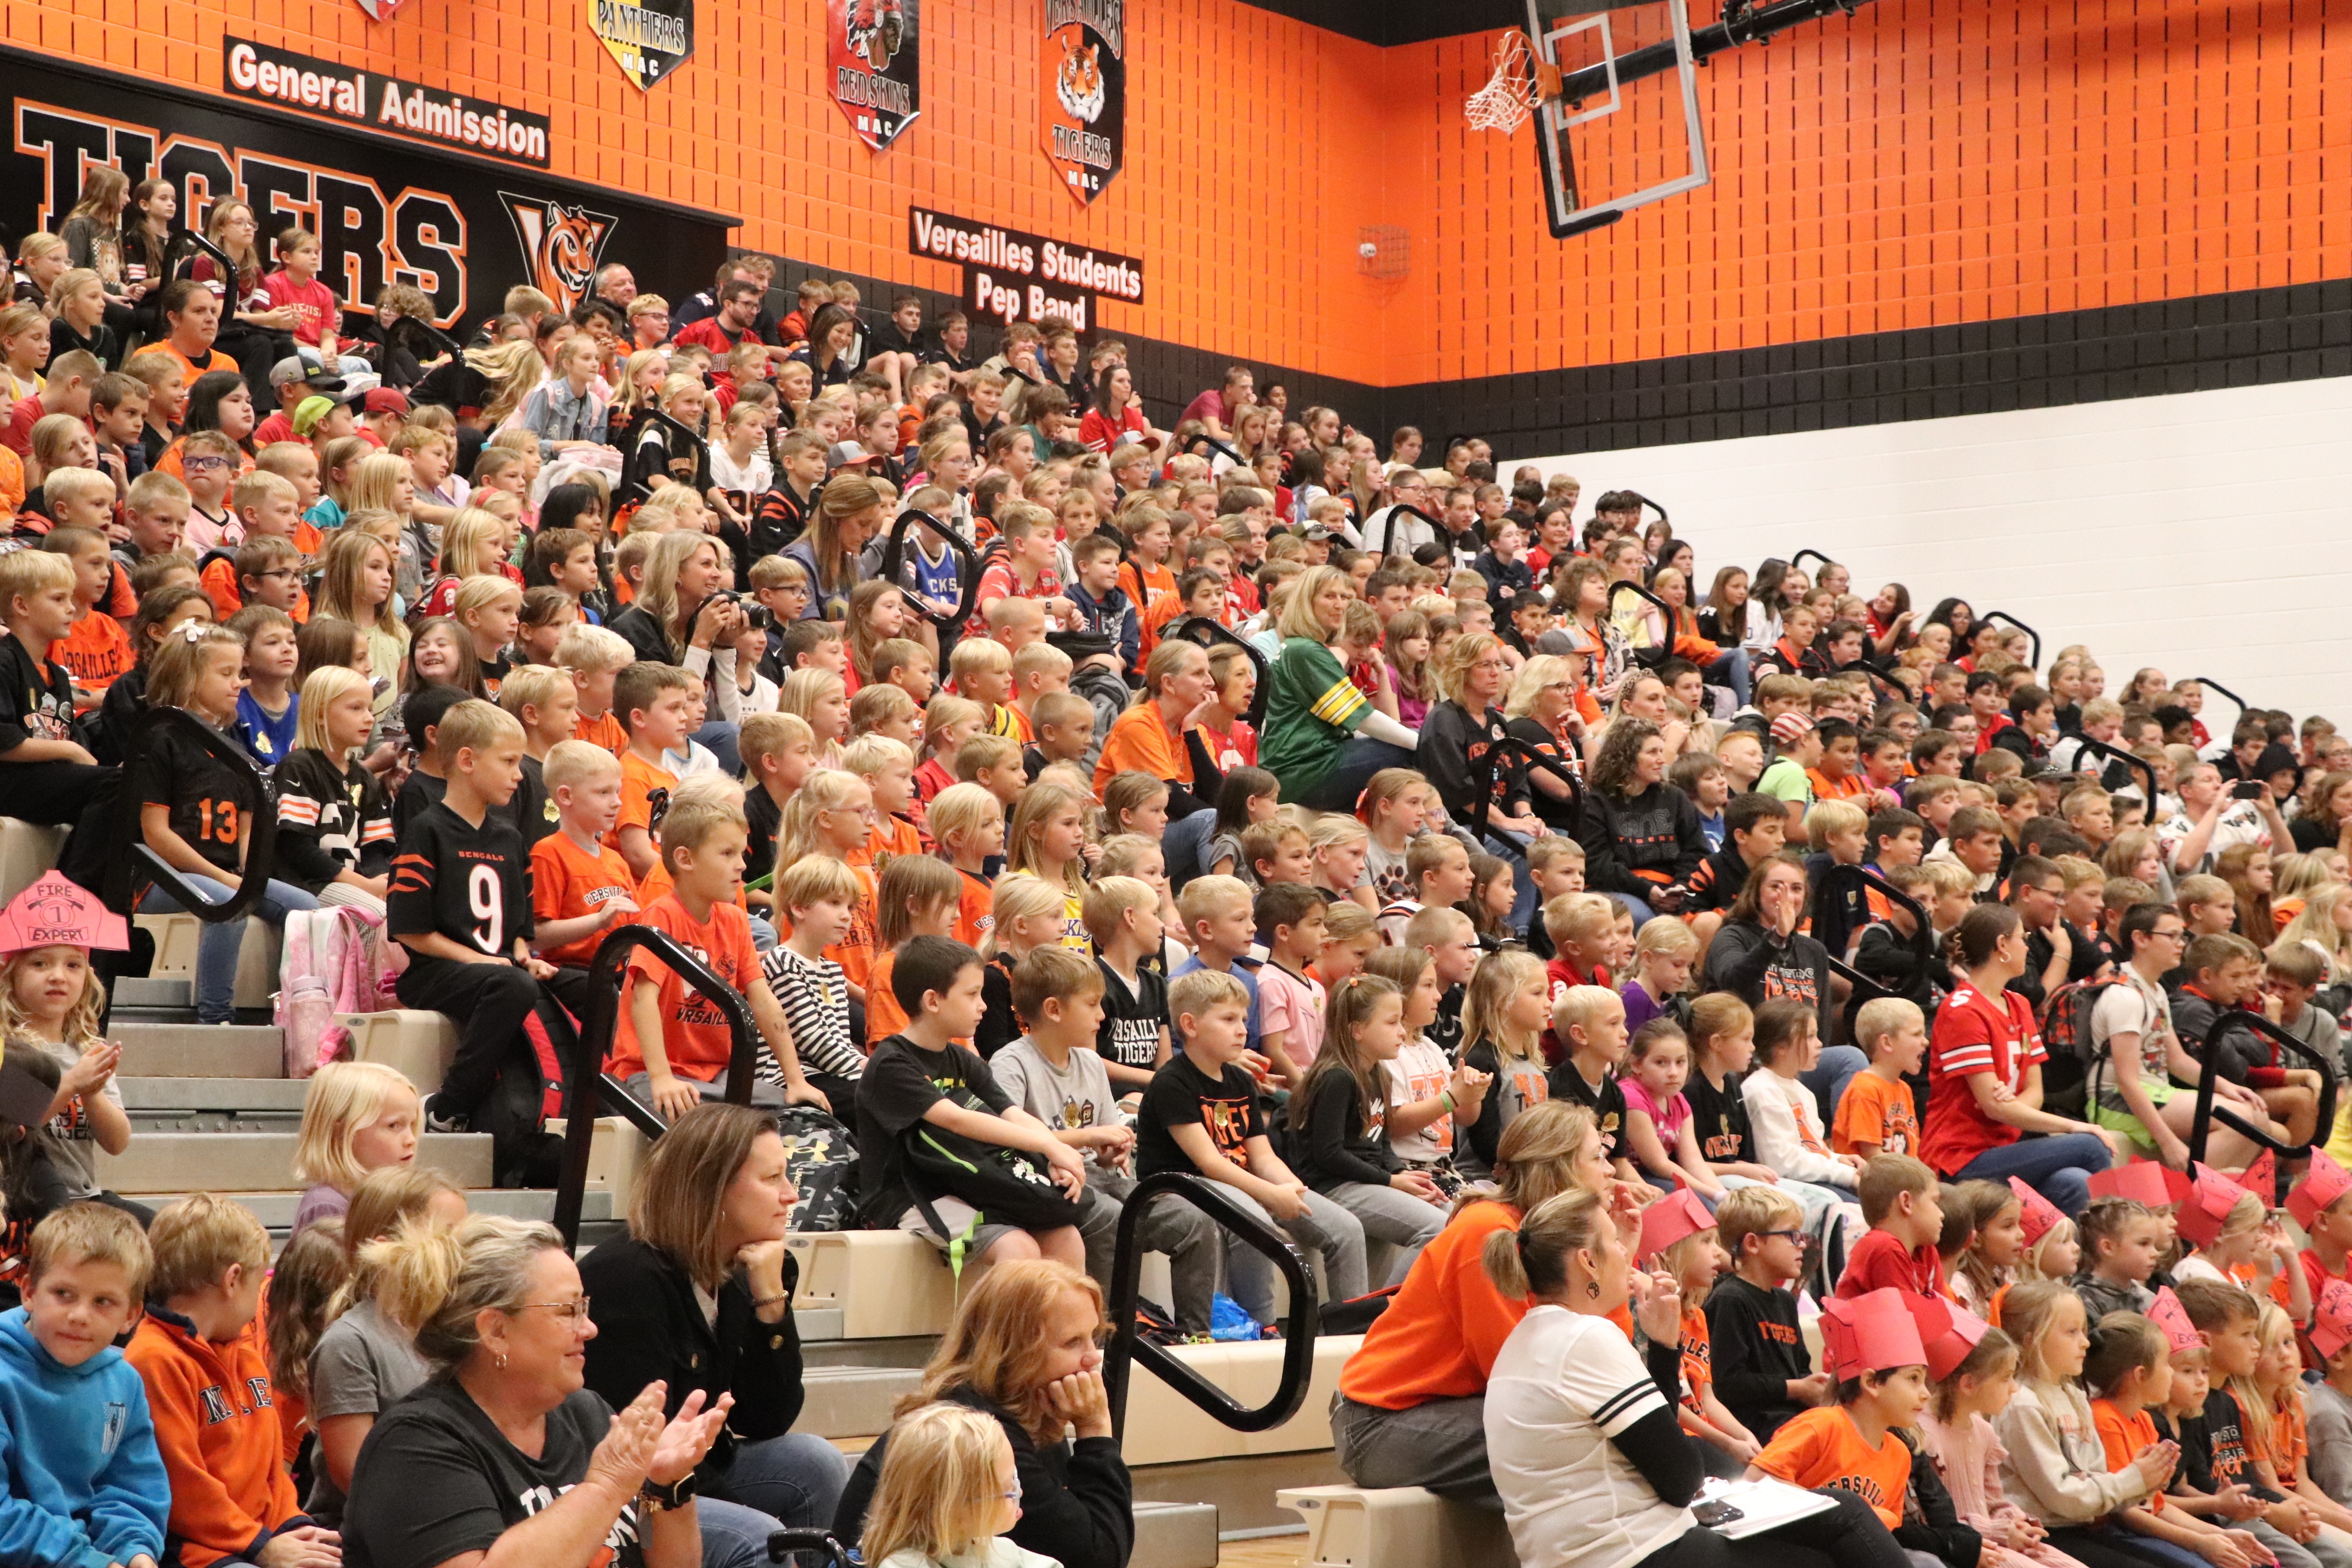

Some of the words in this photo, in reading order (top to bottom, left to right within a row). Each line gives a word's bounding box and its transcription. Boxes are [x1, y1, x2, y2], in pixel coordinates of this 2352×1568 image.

[596, 0, 685, 55] PANTHERS
[229, 43, 365, 118] General
[378, 81, 546, 161] Admission
[837, 66, 910, 117] REDSKINS
[1052, 123, 1112, 170] TIGERS
[913, 211, 1034, 275] Versailles
[1041, 241, 1141, 299] Students
[976, 272, 1021, 325] Pep
[1028, 285, 1086, 332] Band
[929, 577, 958, 593] CKS
[198, 798, 237, 844] 13
[459, 851, 505, 861] BENGALS
[37, 884, 73, 897] FIRE
[469, 864, 503, 954] 9
[32, 927, 83, 942] EXPERT
[52, 906, 63, 923] 1
